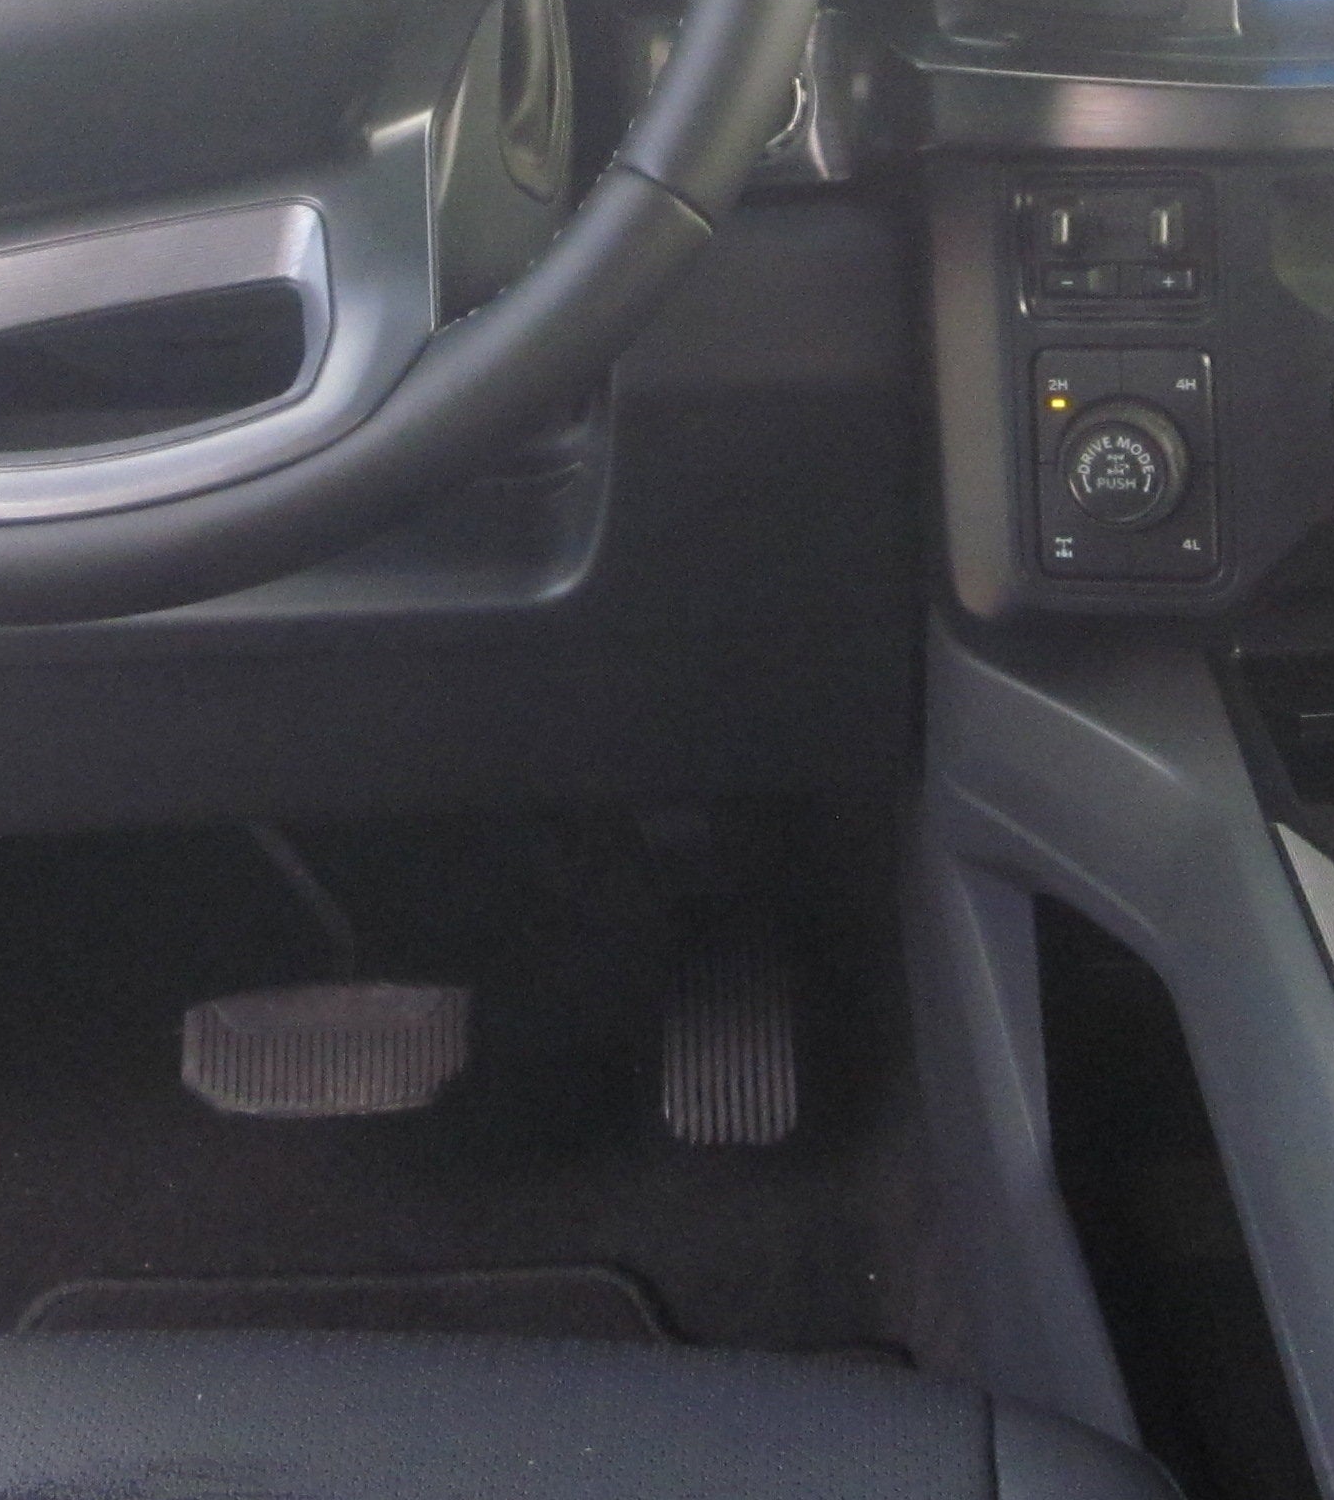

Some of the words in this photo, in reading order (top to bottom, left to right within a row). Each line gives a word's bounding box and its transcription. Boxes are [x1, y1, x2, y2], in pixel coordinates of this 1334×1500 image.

[1047, 378, 1069, 392] 2H
[1174, 377, 1198, 392] 4H
[1077, 436, 1113, 475] DRIVE
[1116, 436, 1156, 476] MODE
[1095, 476, 1138, 492] PUSH
[1180, 538, 1202, 552] 4L
